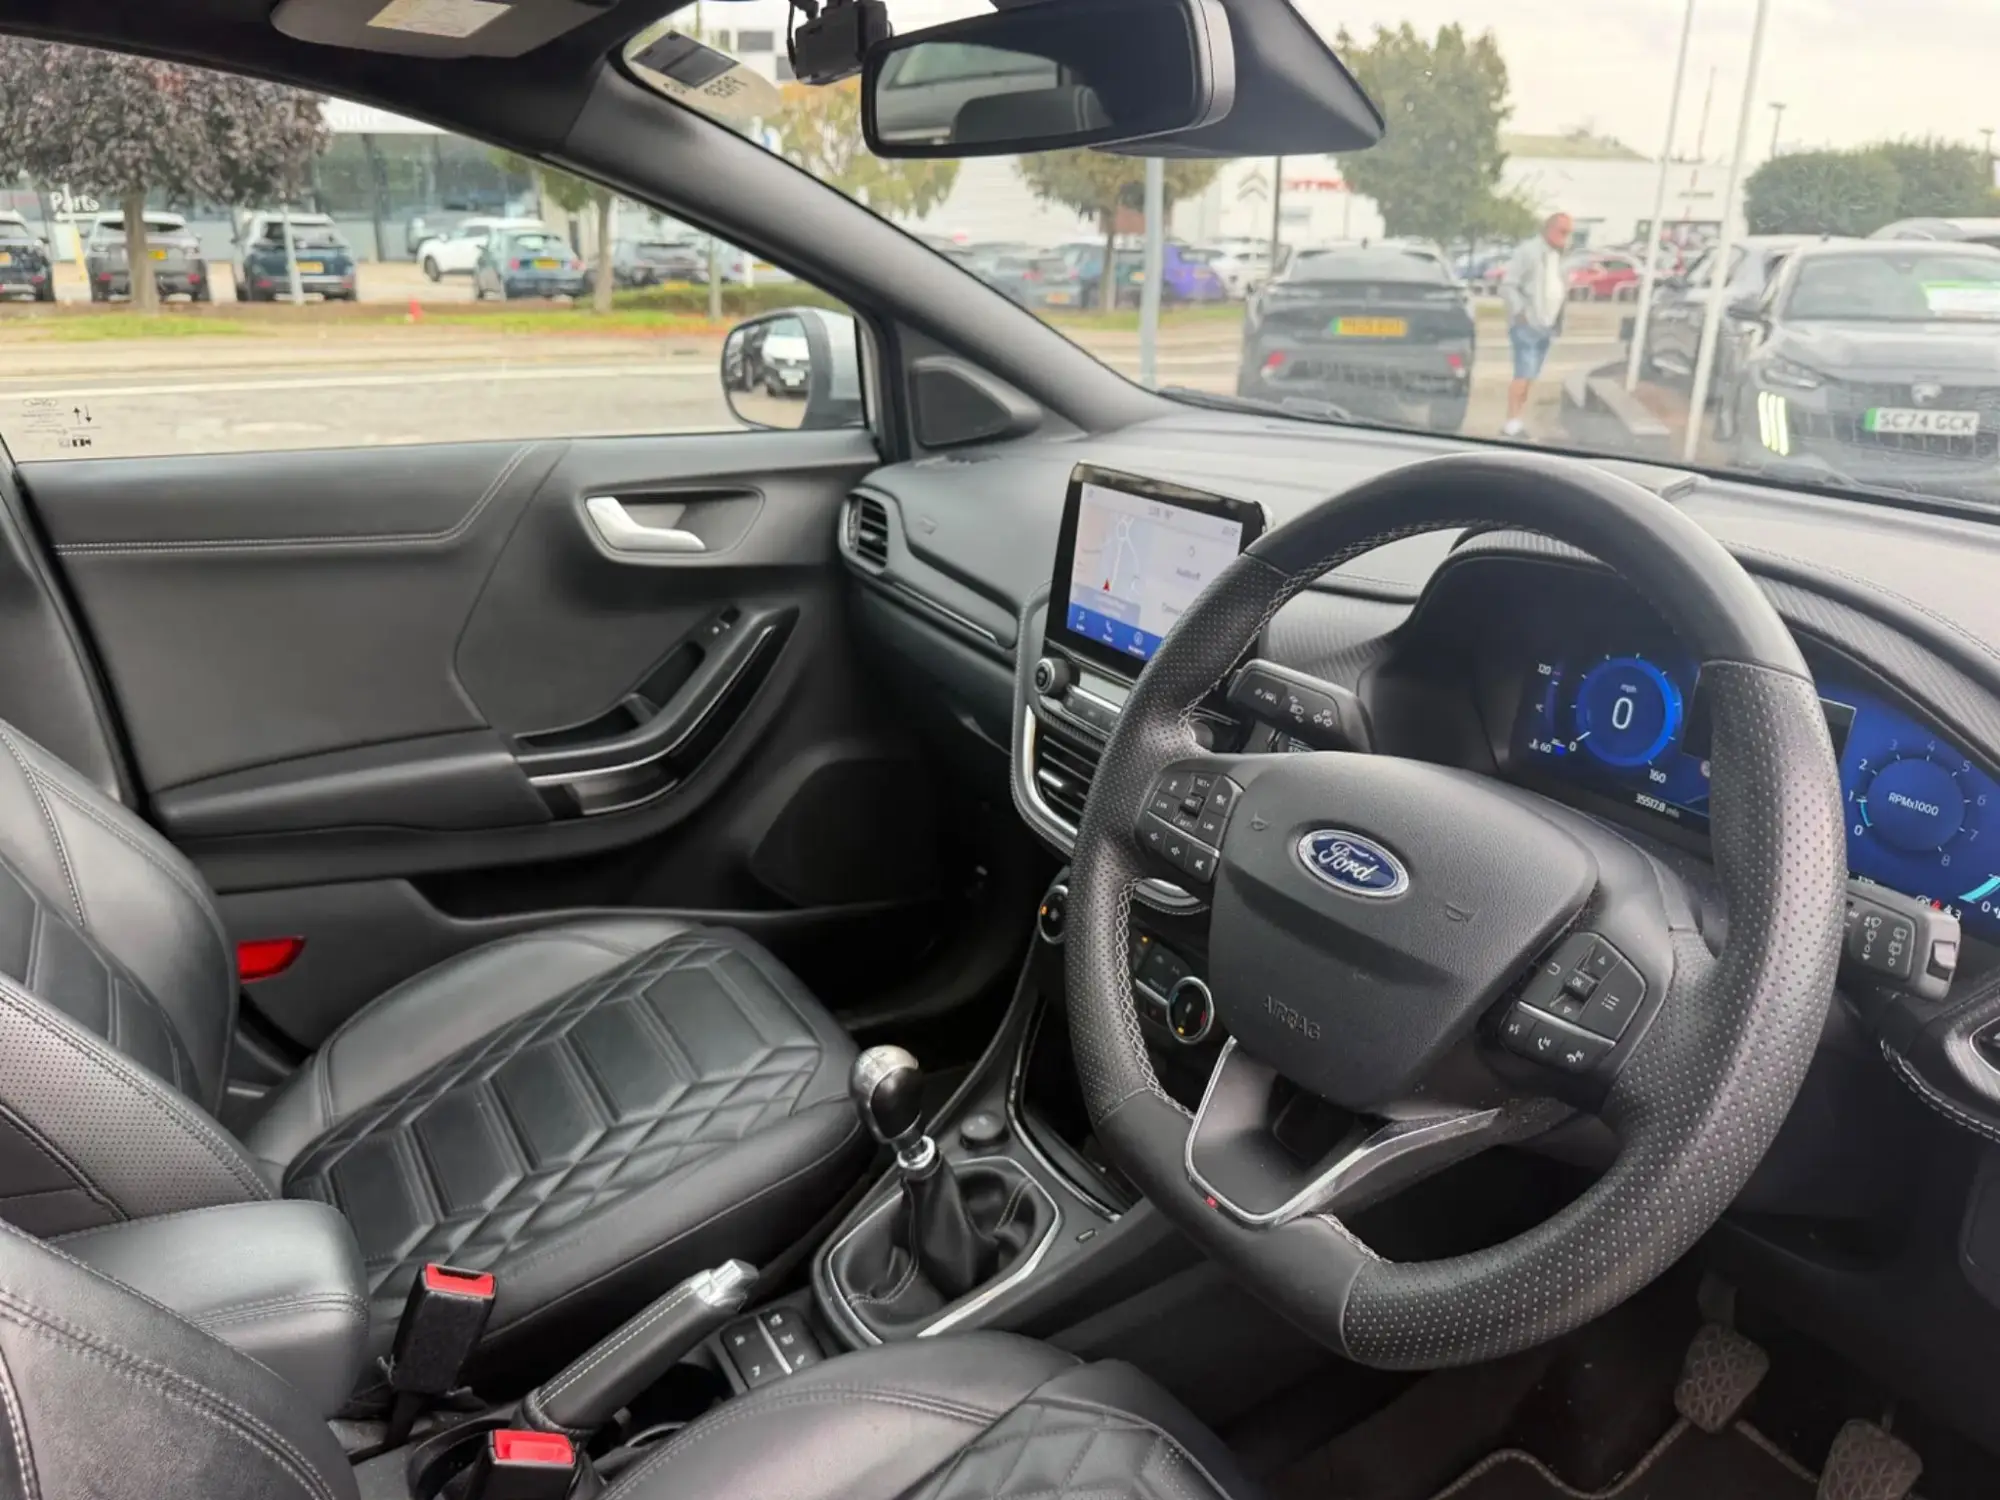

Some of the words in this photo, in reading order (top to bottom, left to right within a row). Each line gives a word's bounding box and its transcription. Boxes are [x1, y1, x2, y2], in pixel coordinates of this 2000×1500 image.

[1621, 684, 1637, 693] mph
[1612, 697, 1634, 730] 0
[1569, 741, 1578, 752] 0
[1890, 739, 1898, 751] 3
[1926, 740, 1936, 751] 4
[1858, 758, 1868, 770] 2
[1961, 760, 1971, 772] 5
[1650, 769, 1666, 783] 160
[1849, 789, 1854, 801] 1
[1977, 794, 1987, 806] 6
[1888, 791, 1940, 817] RPMx1000
[1853, 824, 1864, 836] 0
[1969, 829, 1979, 842] 7
[1318, 841, 1379, 882] Ford
[1941, 855, 1950, 866] 8
[1981, 900, 1991, 912] 0
